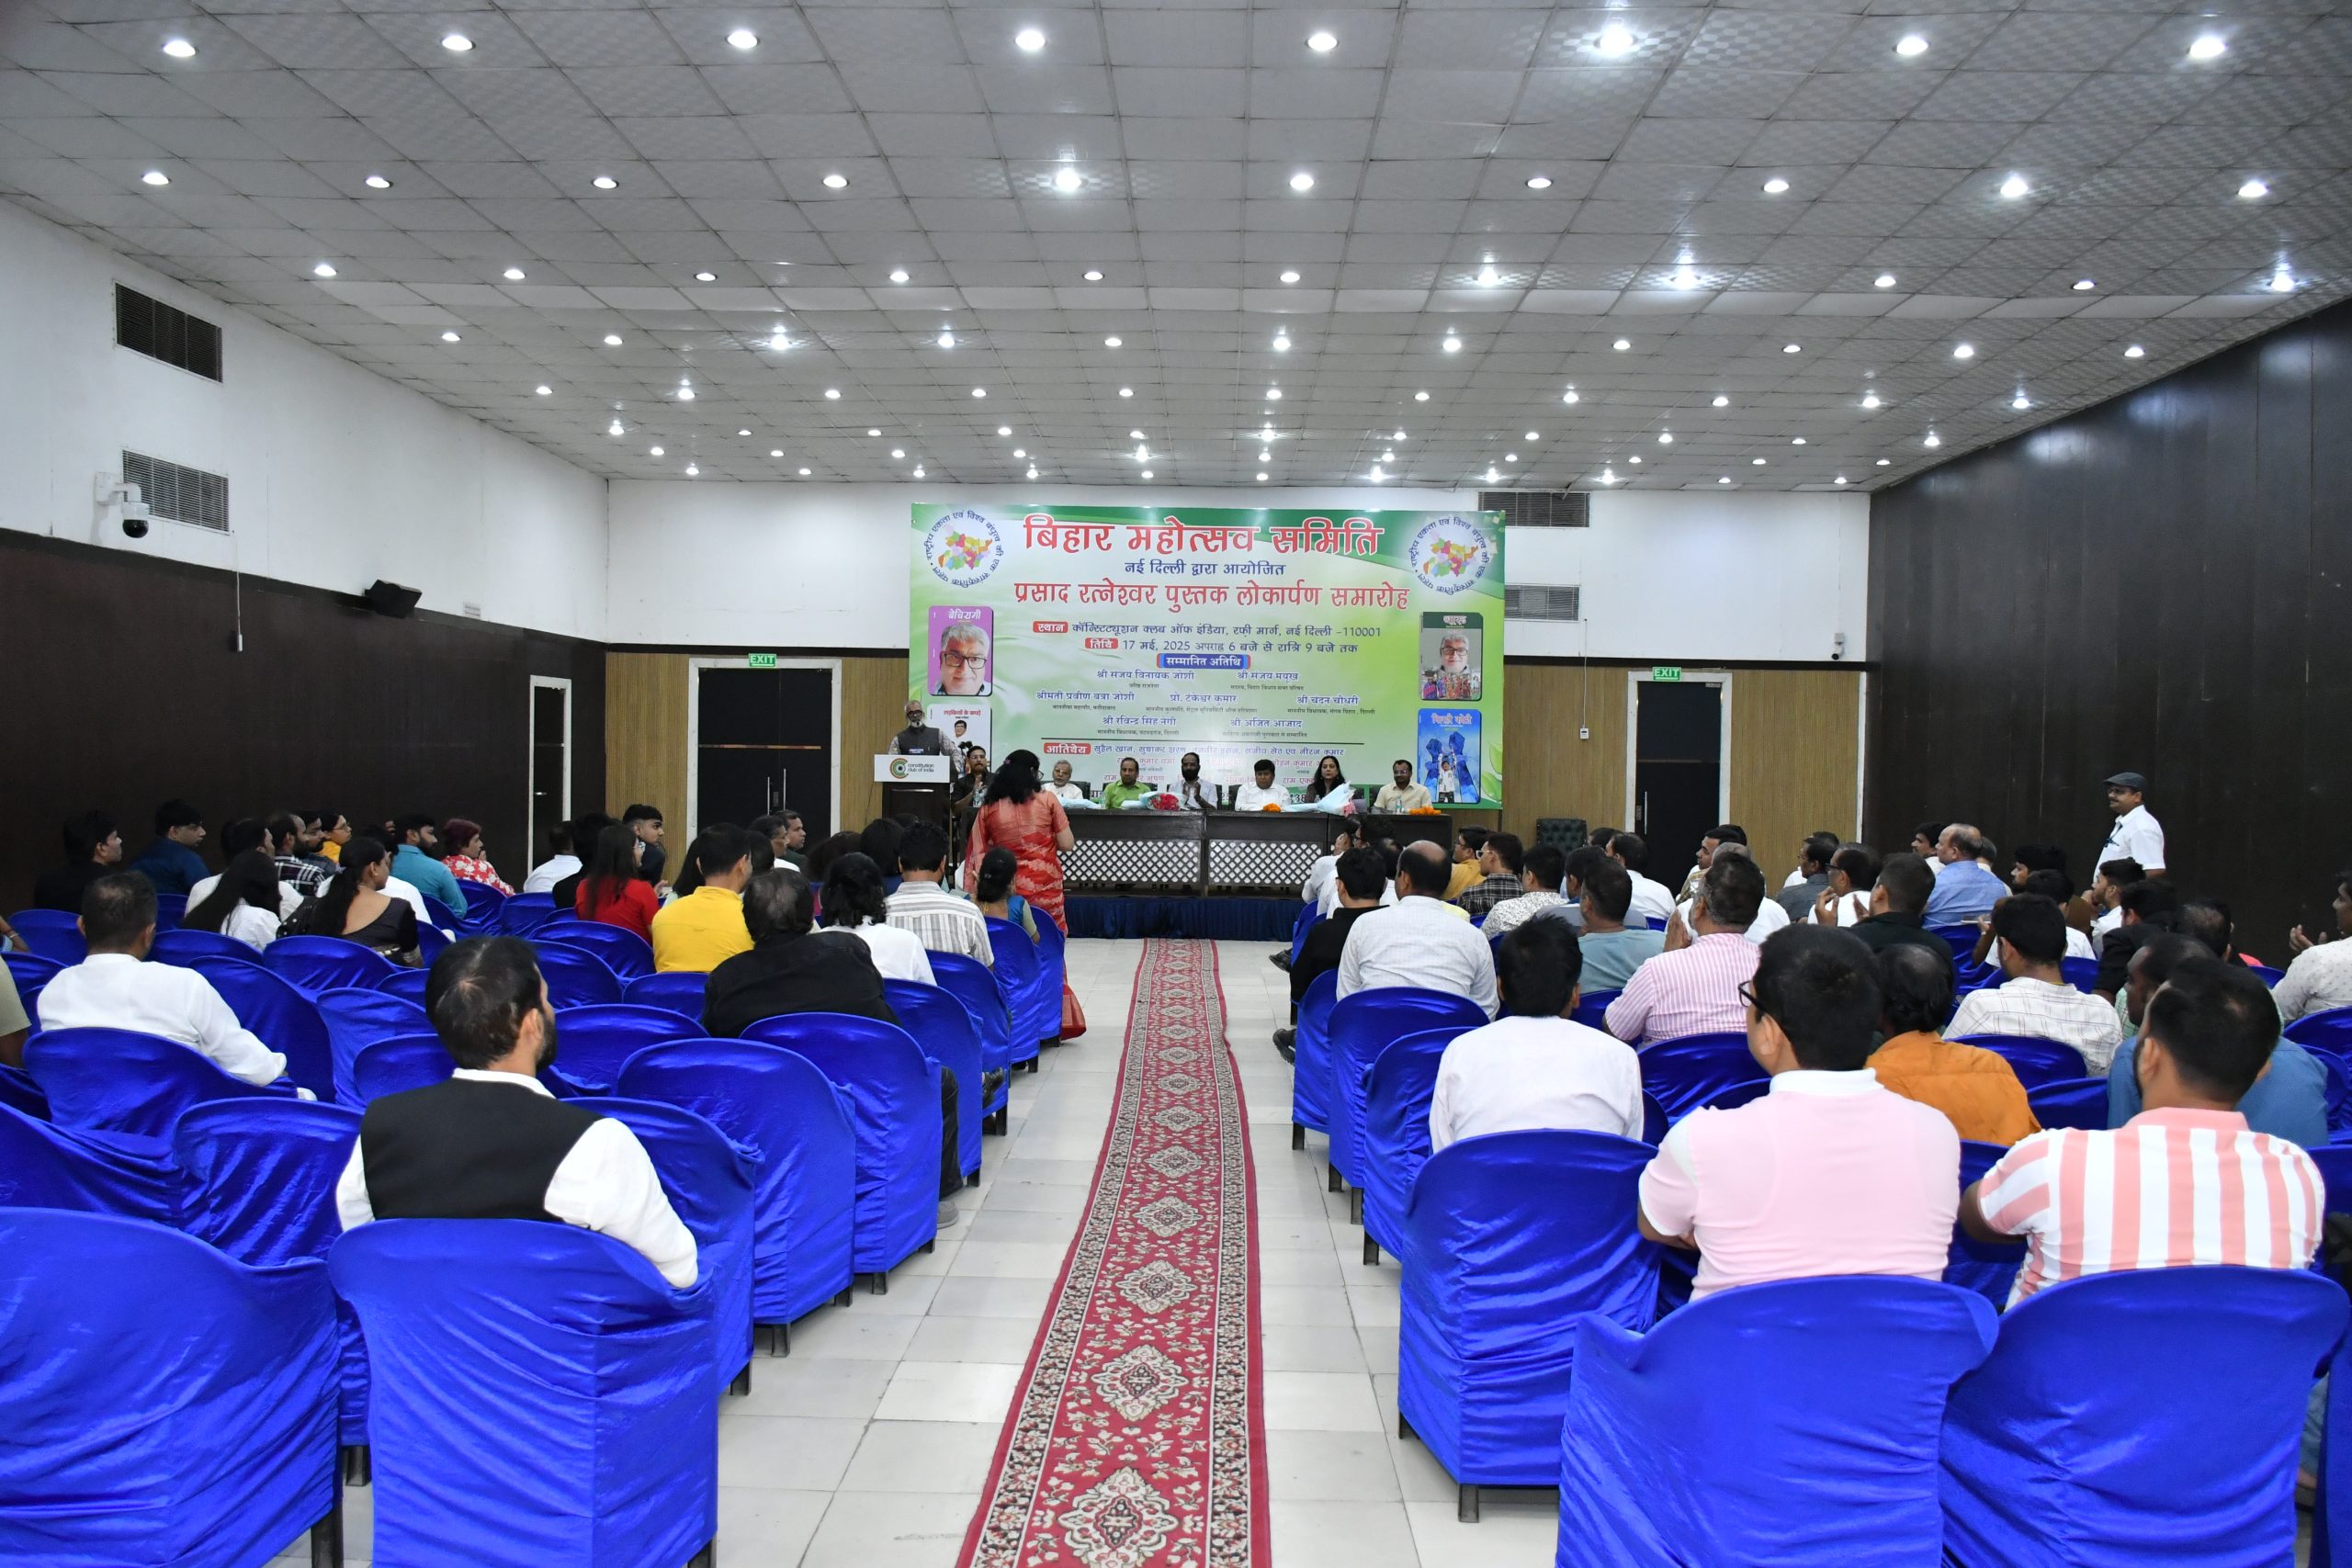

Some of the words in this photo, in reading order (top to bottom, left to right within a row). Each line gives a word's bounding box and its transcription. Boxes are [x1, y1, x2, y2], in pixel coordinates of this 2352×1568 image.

[953, 509, 965, 519] एवं
[967, 510, 985, 524] विश्व
[932, 515, 951, 532] एकता
[1439, 516, 1451, 525] एवं
[1453, 516, 1471, 529] विश्व
[1023, 513, 1115, 553] बिहार
[1126, 515, 1261, 555] महोत्सव
[1270, 516, 1384, 556] समिति
[1417, 522, 1436, 539] एकता
[996, 544, 1003, 557] की
[1482, 551, 1489, 563] की
[989, 558, 1000, 572] एक
[1125, 559, 1145, 574] नई
[1149, 559, 1187, 575] दिल्ली
[1192, 562, 1217, 576] द्वारा
[1223, 559, 1287, 576] आयोजित
[1476, 565, 1486, 580] एक
[1014, 582, 1071, 604] प्रसाद
[1079, 578, 1159, 605] रत्नेश्वर
[1165, 585, 1230, 613] पुस्तक
[1236, 579, 1323, 606] लोकार्पण
[1329, 581, 1410, 610] समारोह
[1037, 623, 1065, 632] स्थान
[1142, 625, 1166, 634] क्लब
[1170, 623, 1193, 634] ऑफ
[1196, 622, 1228, 636] इंडिया,
[1256, 625, 1281, 637] मार्ग,
[1285, 625, 1301, 637] नई
[1305, 626, 1332, 636] दिल्ली
[1090, 638, 1113, 649] तिथि
[1122, 640, 1135, 649] 17
[1139, 638, 1159, 651] मई,
[1163, 640, 1191, 650] 2025
[1228, 642, 1236, 651] 6
[1239, 641, 1259, 651] बजे
[1261, 641, 1273, 651] से
[1278, 641, 1301, 652] रात्रि
[1306, 643, 1313, 652] 9
[1317, 642, 1335, 652] बजे
[1340, 644, 1359, 653] तक
[751, 655, 775, 663] EXIT
[1166, 655, 1207, 666] सम्मानित
[1210, 655, 1241, 667] अतिथि
[1097, 669, 1108, 679] श्री
[1110, 671, 1133, 679] संजय
[1135, 669, 1170, 680] विनायक
[1173, 670, 1195, 680] जोशी
[1238, 670, 1248, 680] श्री
[1250, 671, 1273, 680] संजय
[1654, 669, 1679, 677] EXIT
[1036, 690, 1063, 699] श्रीमती
[1113, 691, 1135, 700] जोशी
[1170, 692, 1182, 702] प्रो.
[1214, 694, 1237, 705] कुमार
[1297, 694, 1307, 704] श्री
[1333, 695, 1358, 705] चौधरी
[1102, 715, 1113, 724] श्री
[1142, 716, 1158, 725] सिंह
[1160, 716, 1176, 726] नेगी
[1230, 717, 1240, 727] श्री
[1245, 717, 1270, 727] अजित
[1046, 743, 1088, 753] आतिथेय
